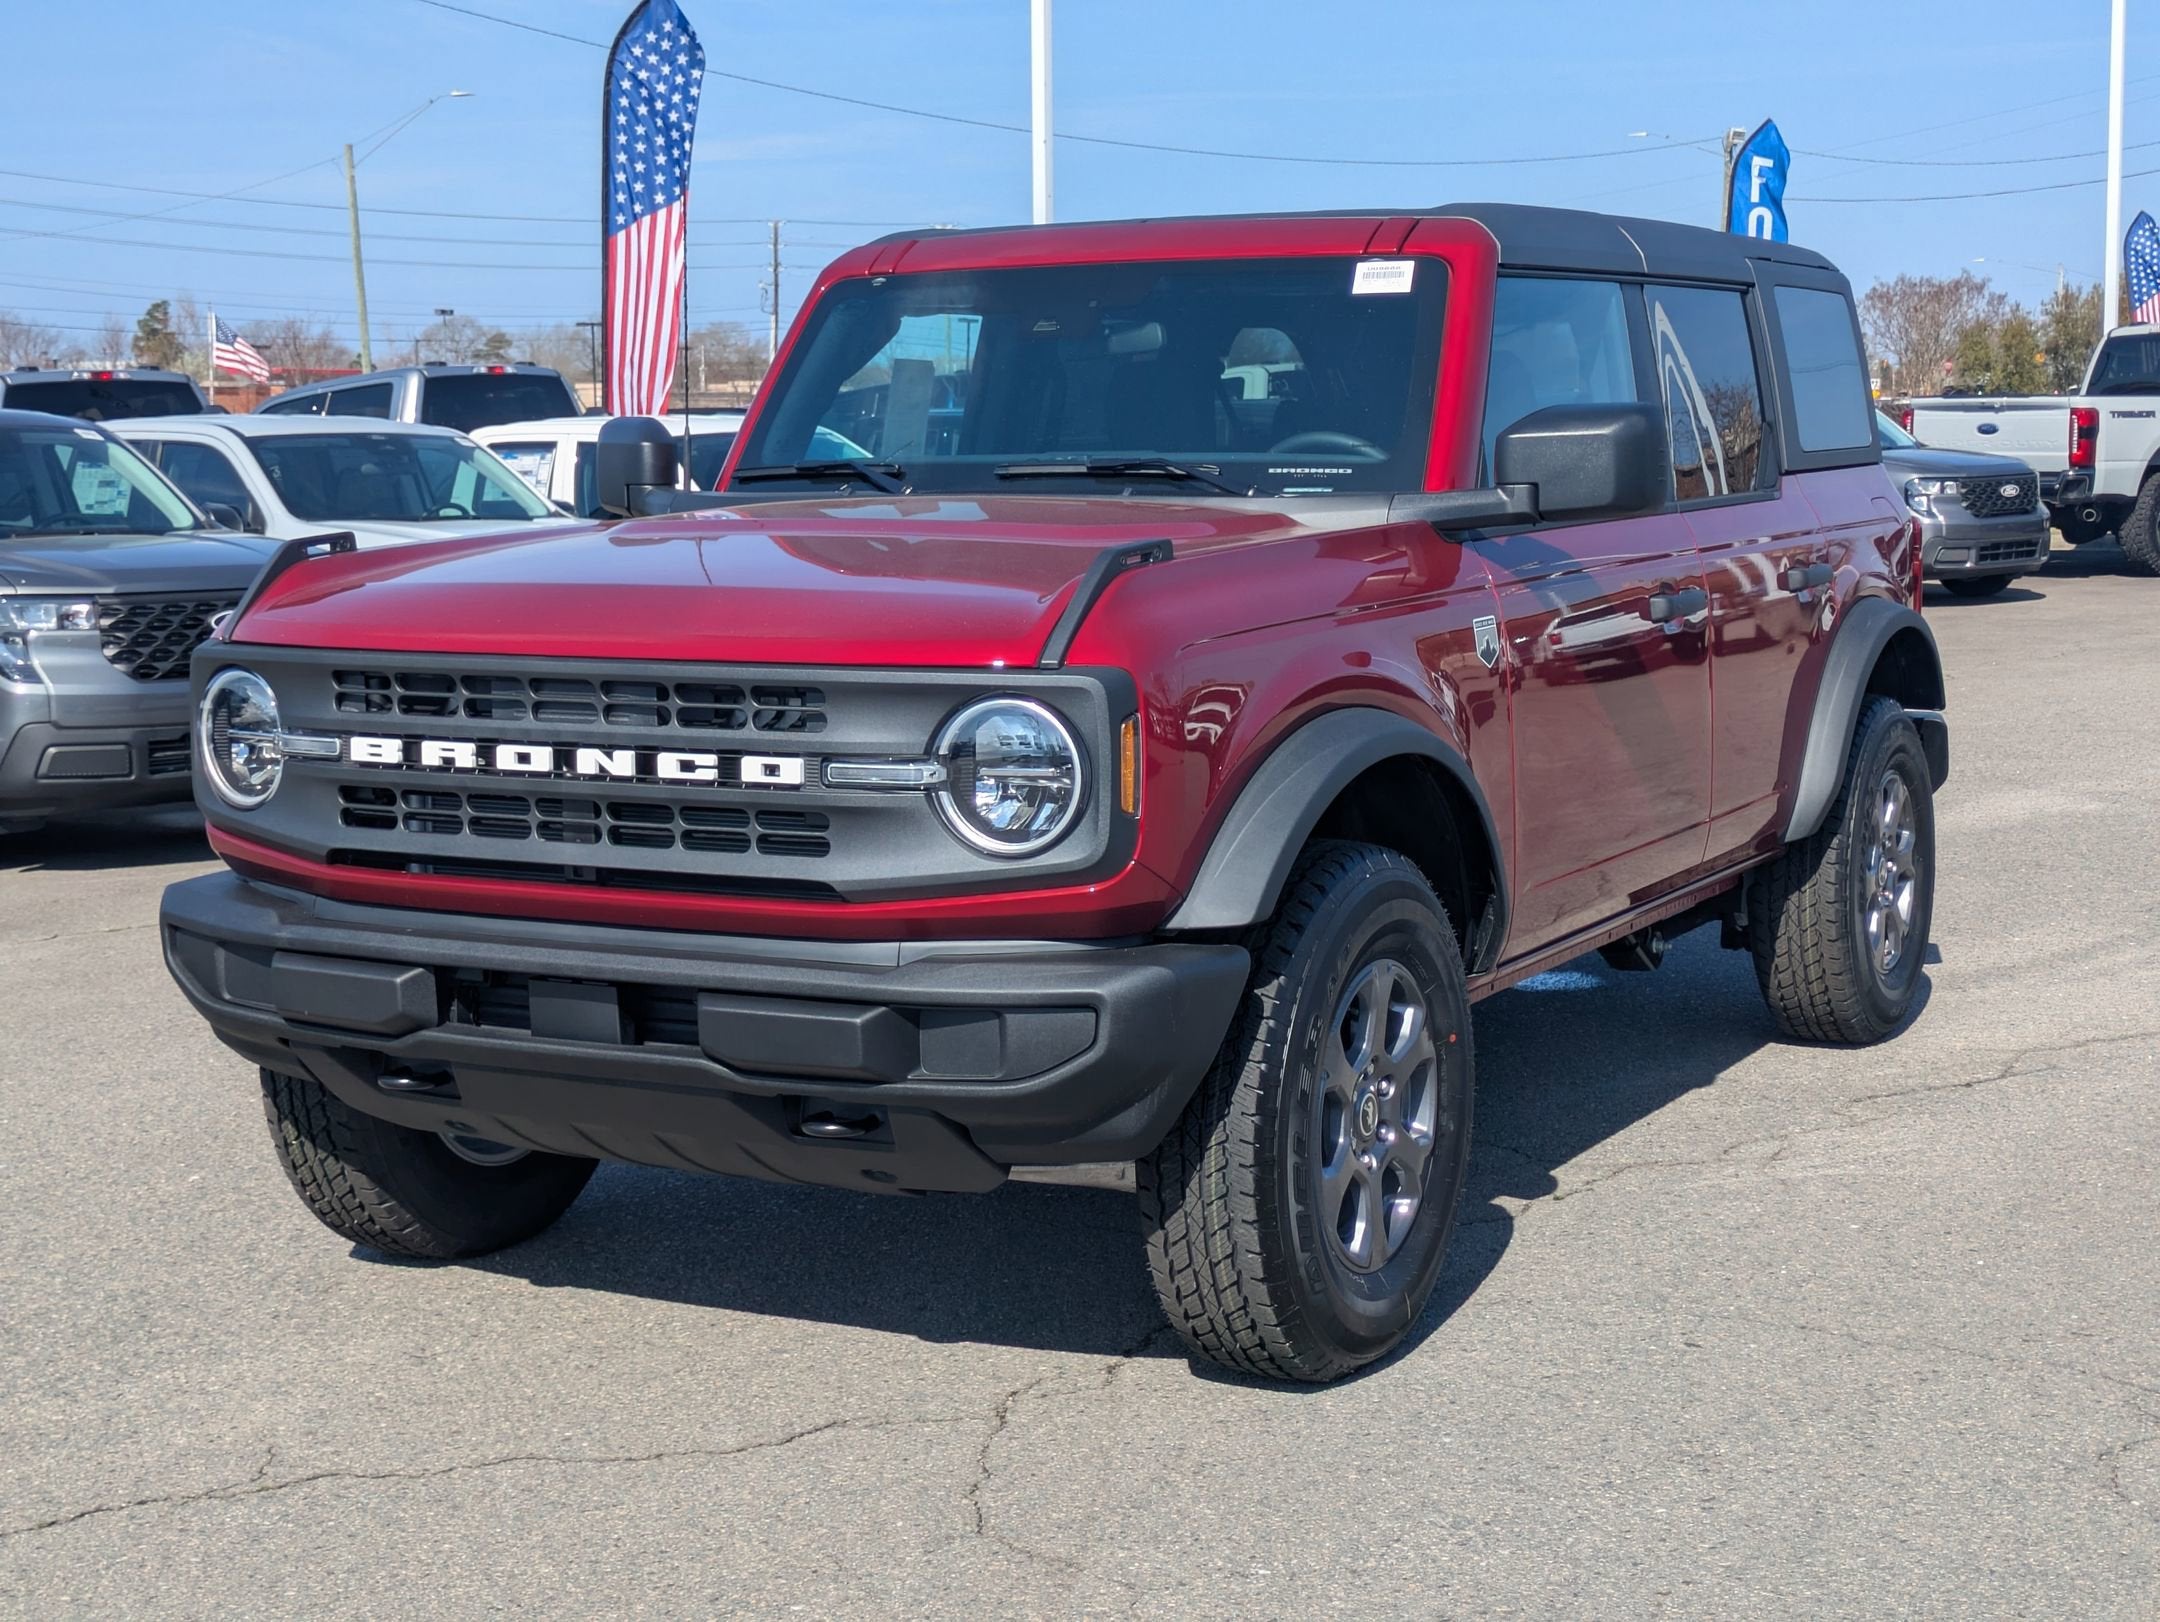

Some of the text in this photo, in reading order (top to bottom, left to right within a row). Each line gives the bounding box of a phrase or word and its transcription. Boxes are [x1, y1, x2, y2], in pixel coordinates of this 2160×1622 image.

[2109, 410, 2157, 419] TREMOR
[1268, 467, 1353, 475] BRONCO
[350, 735, 805, 785] BRONCO
